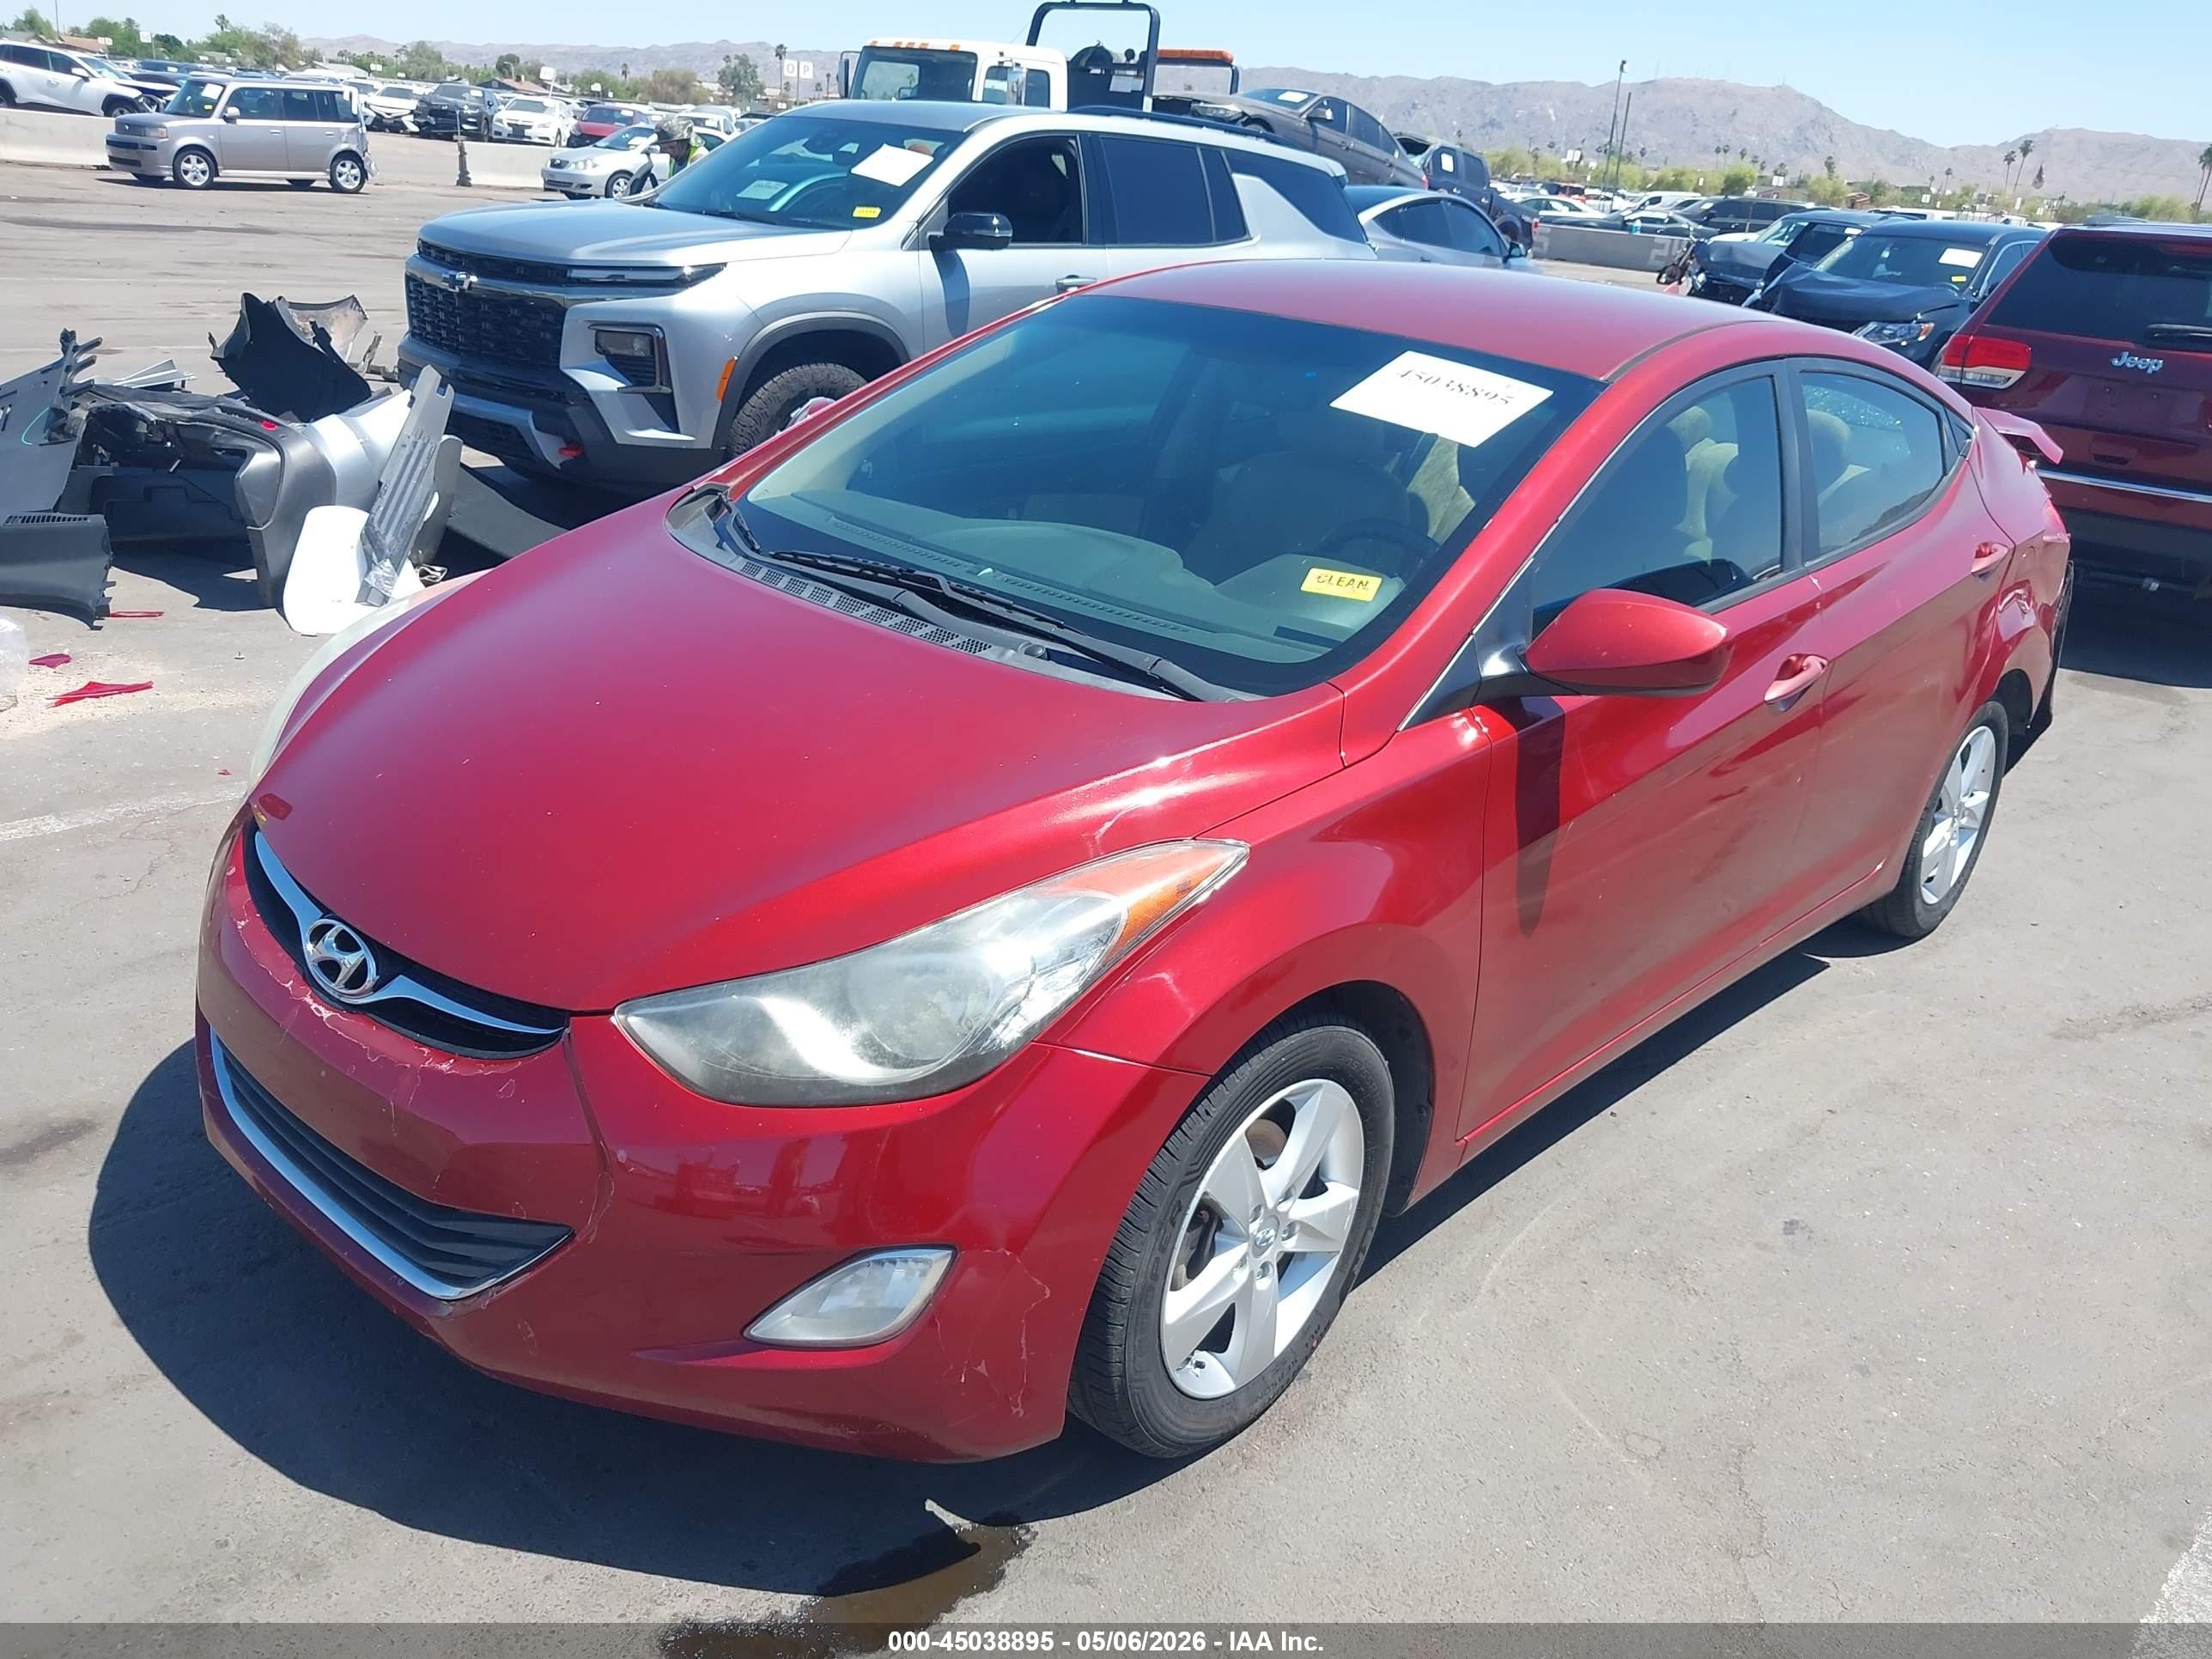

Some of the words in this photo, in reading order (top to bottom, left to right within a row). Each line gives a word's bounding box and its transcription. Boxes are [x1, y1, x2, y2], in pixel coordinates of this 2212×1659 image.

[2110, 351, 2164, 373] Jeep
[1395, 368, 1515, 404] 45038895
[1316, 573, 1370, 591] CLEAN
